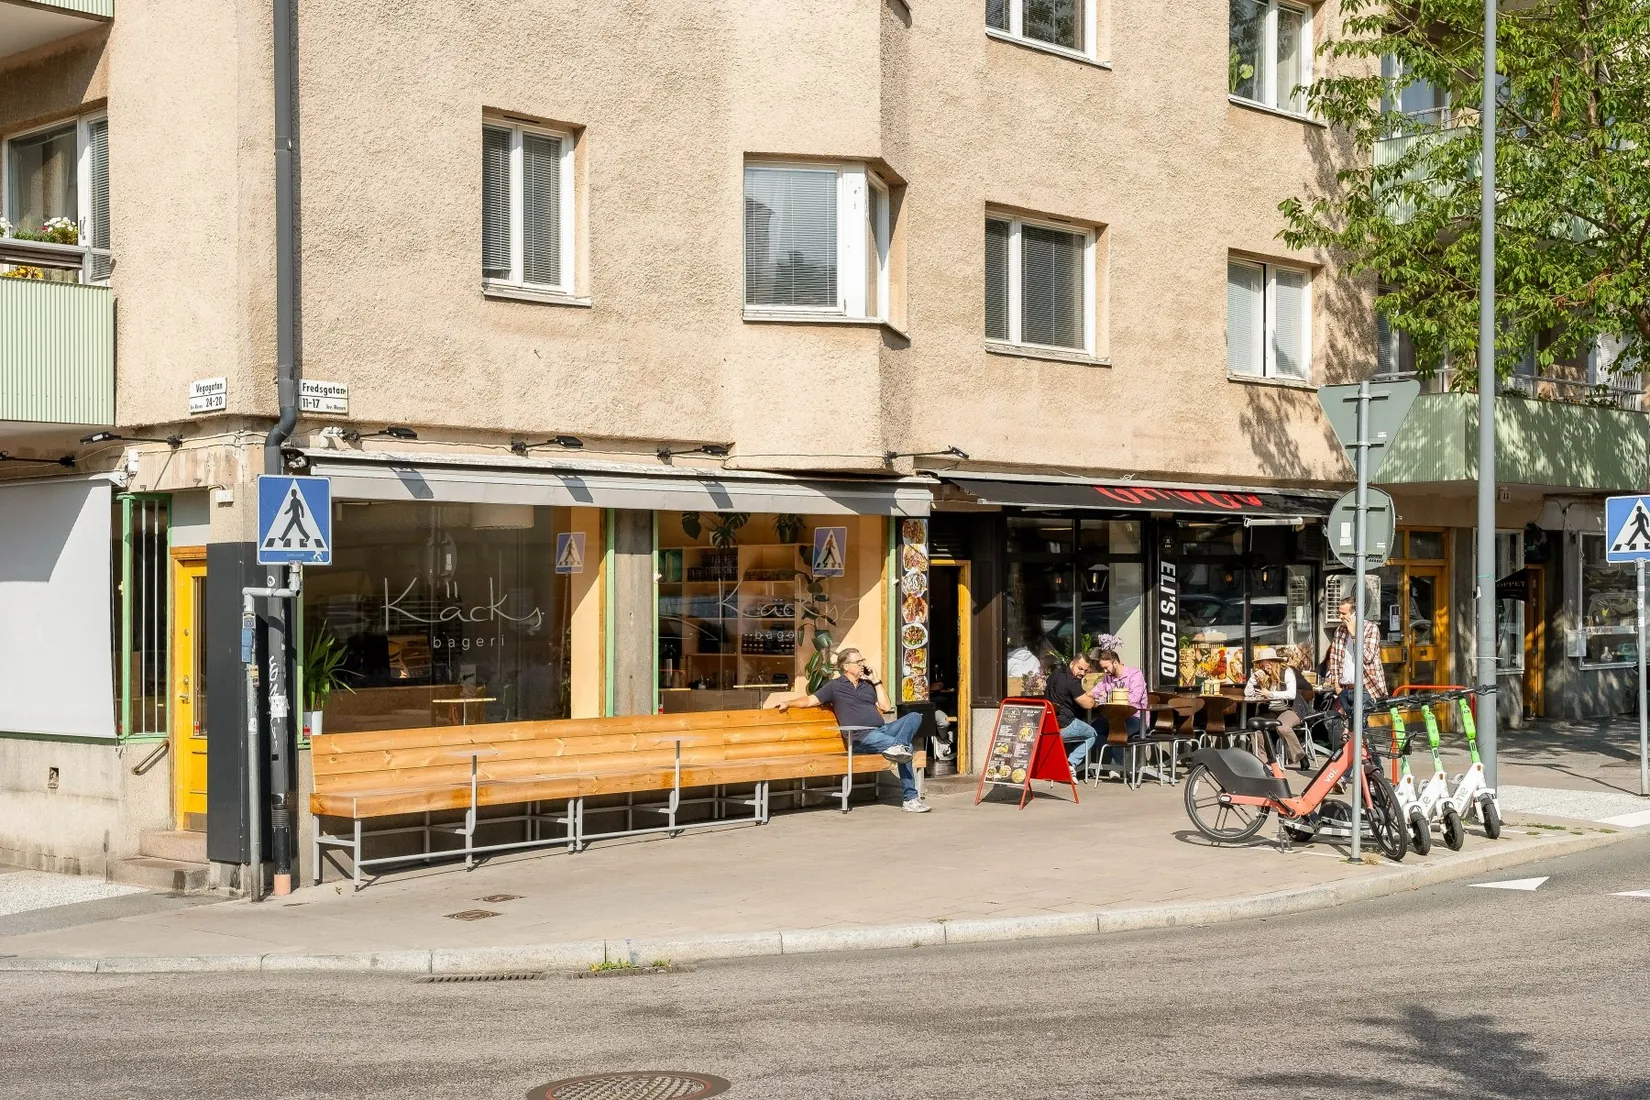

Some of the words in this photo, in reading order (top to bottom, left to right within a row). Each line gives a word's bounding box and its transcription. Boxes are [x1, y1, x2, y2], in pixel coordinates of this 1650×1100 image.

[195, 382, 223, 395] Vegagatan
[302, 382, 346, 396] Fredsgatan
[205, 396, 223, 408] 24-20
[302, 397, 320, 408] 11-17
[1160, 560, 1176, 616] ELI'S
[433, 634, 505, 651] bageri
[755, 630, 795, 642] bage
[1160, 619, 1177, 678] FOOD
